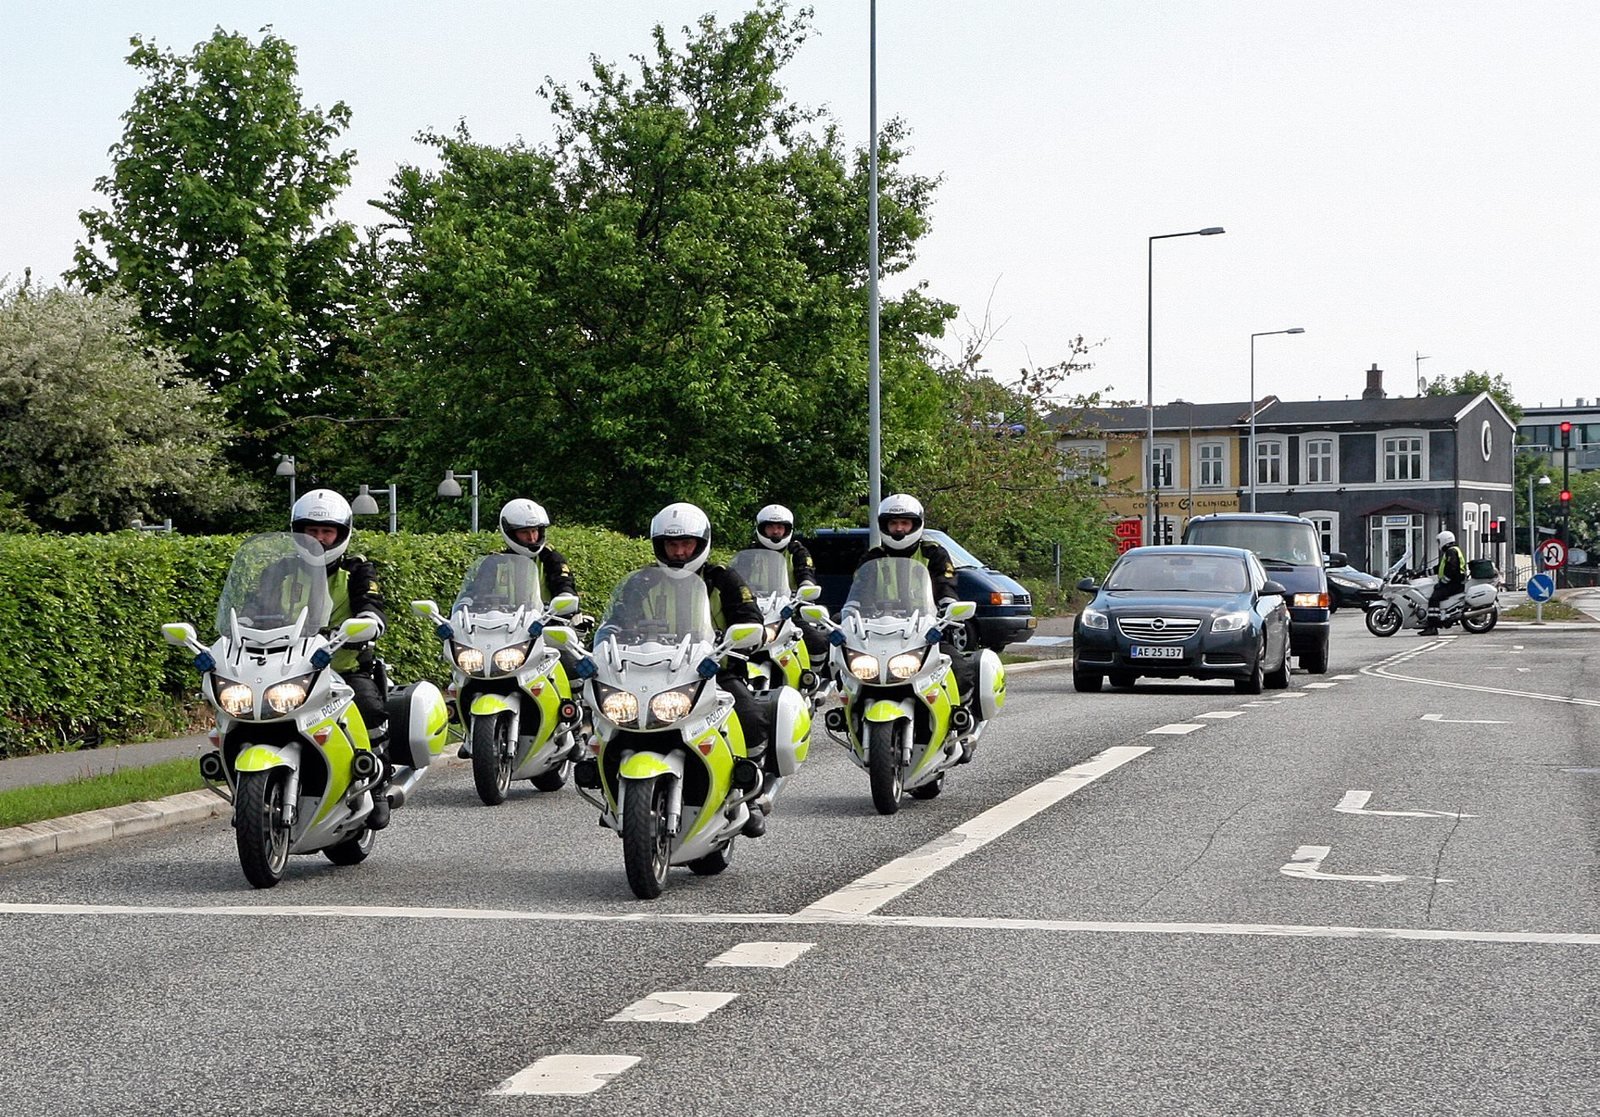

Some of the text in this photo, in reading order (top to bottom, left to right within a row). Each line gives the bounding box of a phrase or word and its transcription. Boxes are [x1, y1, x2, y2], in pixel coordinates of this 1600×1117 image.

[1132, 500, 1238, 510] COORT CLINIQUE
[1116, 523, 1137, 535] 204
[1137, 647, 1182, 658] AE 25 137
